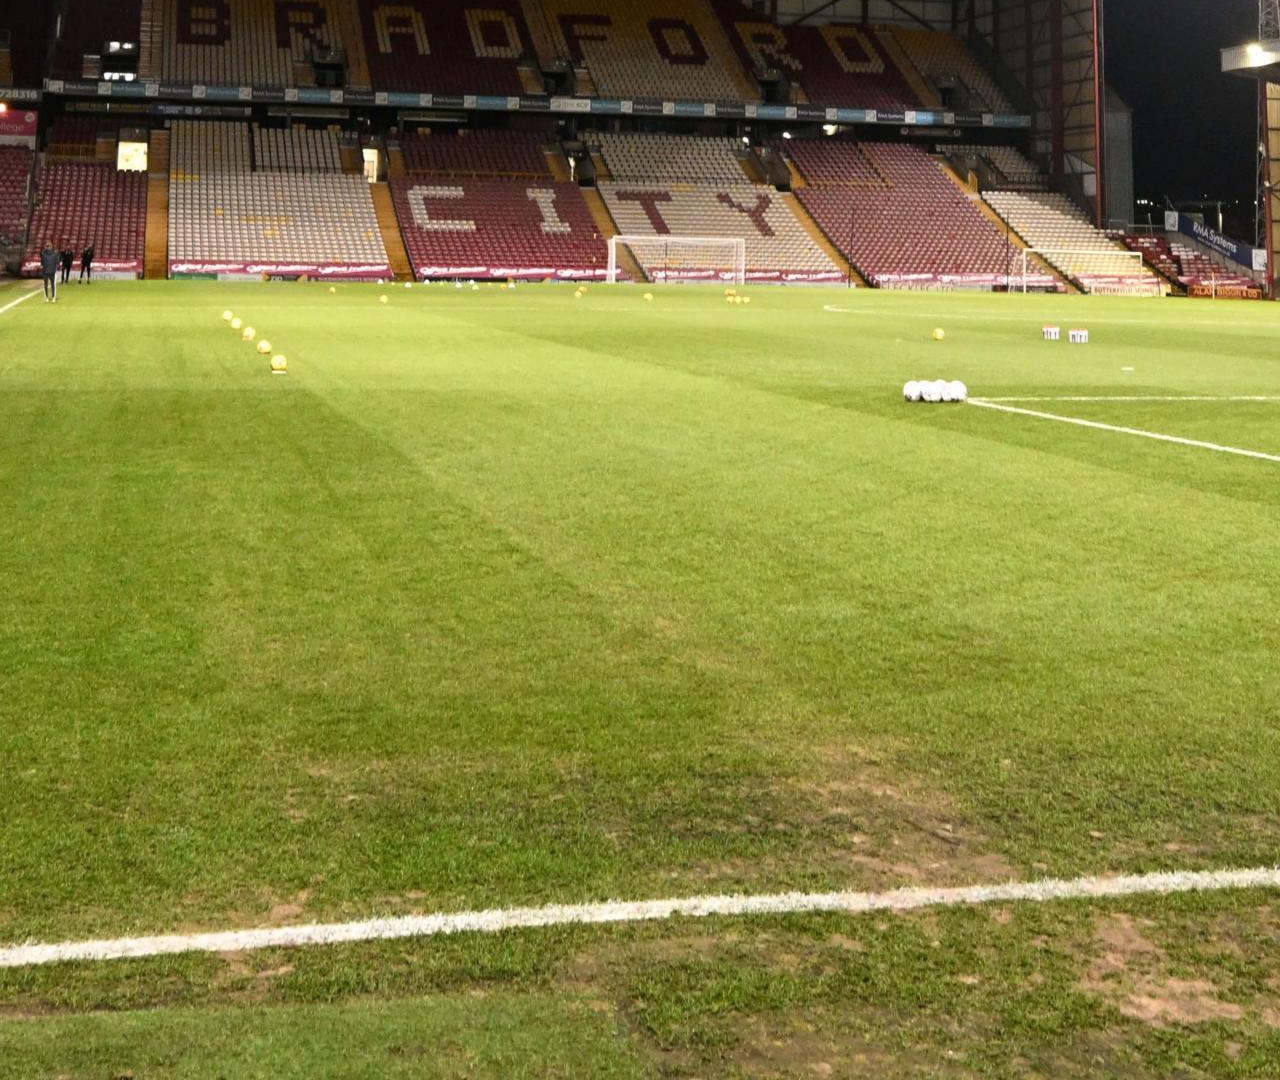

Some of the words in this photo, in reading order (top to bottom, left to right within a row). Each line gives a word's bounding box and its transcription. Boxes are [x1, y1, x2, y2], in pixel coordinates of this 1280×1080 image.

[407, 184, 775, 236] CITY
[1193, 221, 1209, 239] RMA
[1209, 229, 1237, 253] Systems
[1193, 286, 1213, 295] ALAN
